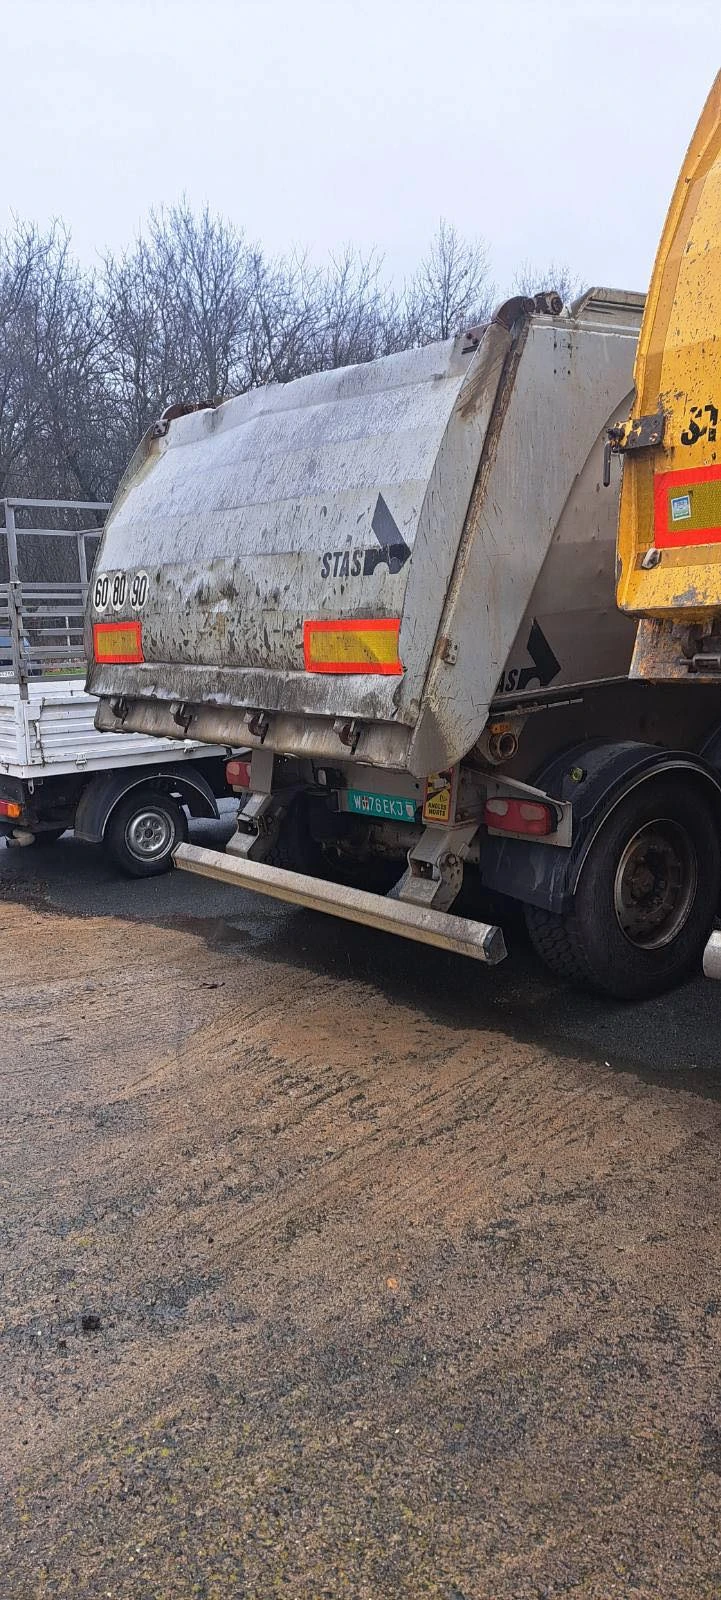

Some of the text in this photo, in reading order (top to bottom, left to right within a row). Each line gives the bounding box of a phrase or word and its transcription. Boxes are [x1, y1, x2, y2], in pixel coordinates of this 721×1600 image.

[321, 549, 362, 578] STAS
[94, 575, 148, 606] 60 80 90
